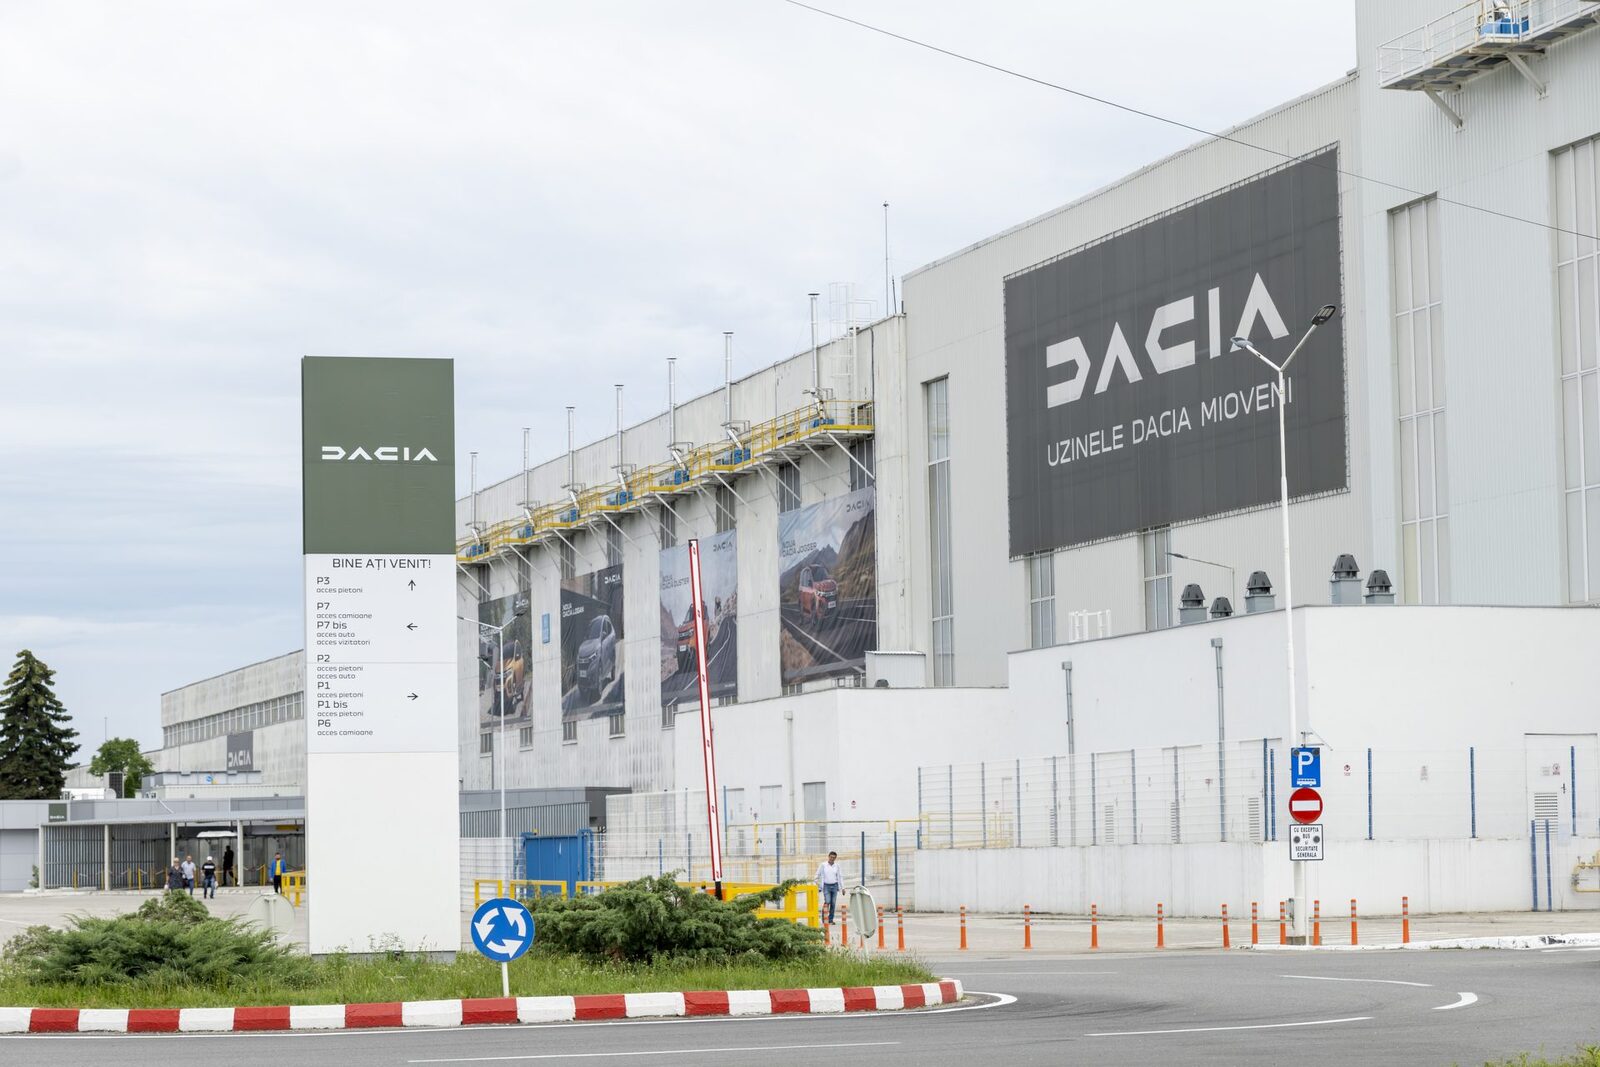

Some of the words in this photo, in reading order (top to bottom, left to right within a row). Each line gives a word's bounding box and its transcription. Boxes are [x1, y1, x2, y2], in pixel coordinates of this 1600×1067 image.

[1046, 272, 1290, 408] DACIA
[1047, 424, 1124, 467] UZINELE
[1132, 406, 1192, 444] DACIA
[1201, 376, 1293, 427] MIOVENI
[321, 445, 439, 461] DACIA
[332, 558, 363, 569] BINE
[365, 558, 387, 571] AȚI
[390, 558, 431, 569] VENIT!
[316, 576, 330, 585] P3
[338, 587, 363, 595] pietoni
[316, 602, 330, 611] P7
[338, 612, 373, 620] camioane
[316, 621, 330, 630] P7
[332, 621, 348, 631] bis
[317, 654, 331, 663] P2
[338, 664, 364, 673] pietoni
[317, 681, 331, 690] P1
[338, 691, 364, 699] pietoni
[317, 700, 331, 709] P1
[333, 700, 348, 709] bis
[338, 710, 364, 718] pietoni
[317, 719, 331, 728] P6
[338, 729, 374, 737] camioane
[228, 751, 251, 767] DACIA
[1298, 752, 1314, 775] P
